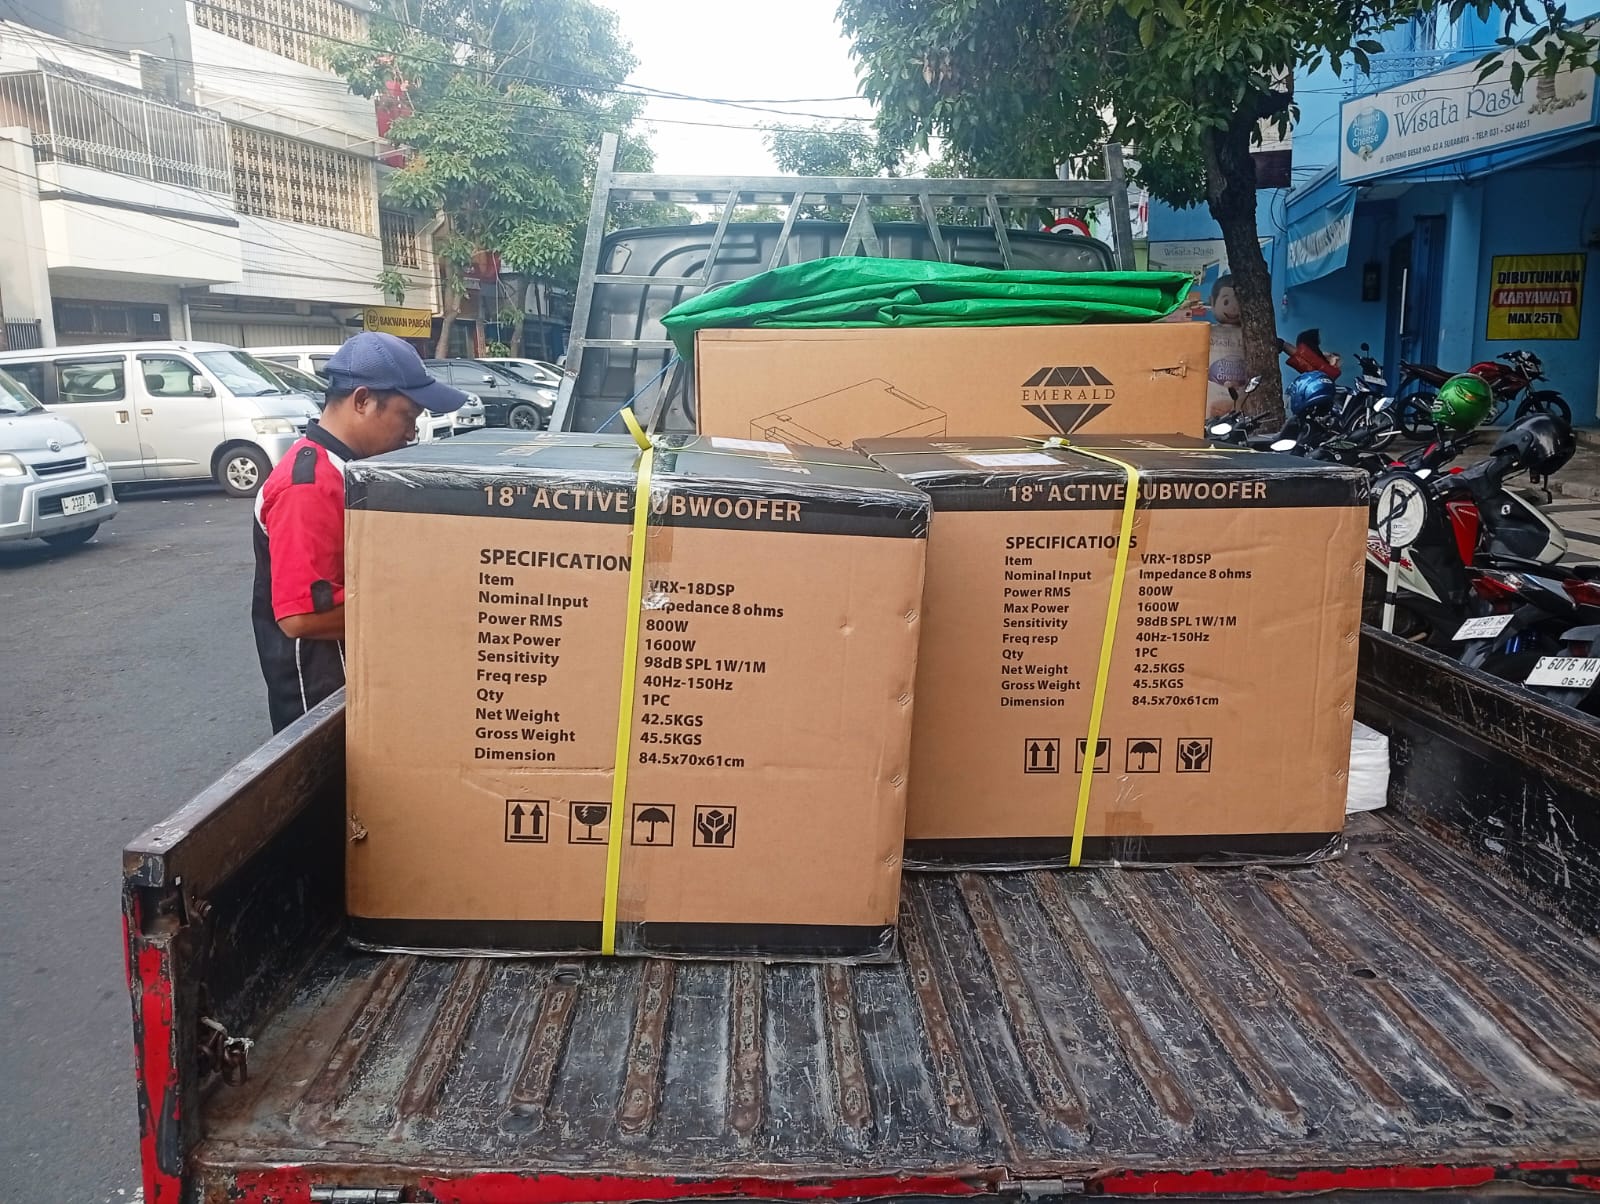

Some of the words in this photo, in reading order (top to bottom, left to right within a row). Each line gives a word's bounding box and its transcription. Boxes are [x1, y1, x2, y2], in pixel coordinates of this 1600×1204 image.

[1394, 88, 1427, 108] TOKO
[1394, 97, 1460, 137] Wisata
[1465, 87, 1526, 119] Rasa
[1354, 127, 1377, 138] Crispy
[1352, 134, 1379, 148] Cheese
[1443, 135, 1470, 148] SURABAYA
[1498, 290, 1572, 305] KARYAWATI
[380, 316, 407, 328] BAKWAN
[408, 318, 431, 329] PABEAN
[1507, 312, 1532, 325] MAX
[1022, 388, 1116, 401] EMERALD
[1008, 484, 1043, 502] 18"
[1048, 484, 1125, 502] ACTIVE
[484, 486, 527, 508] 18"
[534, 488, 628, 513] ACTIVE
[650, 495, 801, 522] UBWOOFER
[1006, 536, 1137, 549] SPECIFICATIOS
[1005, 556, 1032, 566] Item
[1141, 554, 1212, 564] VRX-18DSP
[1004, 570, 1056, 580] Nominal
[1059, 570, 1092, 582] Input
[1140, 569, 1206, 580] Impedance
[1209, 570, 1216, 579] 8
[1219, 570, 1252, 579] ohms
[479, 572, 514, 586] Item
[648, 580, 735, 596] VRX-18DSP
[1004, 588, 1042, 597] Power
[1044, 588, 1070, 596] RMS
[1139, 586, 1173, 596] 800W
[479, 591, 544, 606] Nominal
[547, 594, 589, 608] Input
[733, 604, 740, 615] 8
[744, 605, 784, 618] ohms
[1004, 604, 1028, 613] Max
[1032, 603, 1069, 613] Power
[1138, 602, 1180, 612] 1600W
[478, 612, 526, 626] Power
[530, 615, 562, 627] RMS
[646, 619, 688, 632] 800W
[1003, 618, 1068, 630] Sensitivity
[1137, 616, 1168, 626] 98dB
[1170, 616, 1192, 626] SPL
[1196, 616, 1237, 627] 1W/1M
[478, 632, 510, 645] Max
[513, 634, 561, 647] Power
[645, 639, 696, 652] 1600W
[1002, 634, 1030, 645] Freq
[1032, 635, 1058, 645] resp
[1136, 632, 1210, 642] 40Hz-150Hz
[478, 650, 559, 667] Sensitivity
[644, 657, 682, 670] 98dB
[686, 658, 712, 671] SPL
[716, 660, 766, 673] 1W/1M
[1002, 649, 1024, 661] Qty
[1135, 648, 1158, 658] 1PC
[1002, 665, 1024, 674] Net
[1026, 664, 1068, 676] Weight
[1134, 664, 1185, 673] 42.5KGS
[1535, 657, 1546, 670] S
[1547, 658, 1579, 671] 6076
[477, 669, 511, 684] Freq
[514, 673, 547, 686] resp
[643, 676, 733, 691] 40Hz-150Hz
[1002, 680, 1035, 690] Gross
[1038, 680, 1080, 691] Weight
[1133, 679, 1184, 688] 45.5KGS
[476, 689, 504, 703] Qty
[642, 695, 670, 706] 1PC
[1001, 697, 1065, 706] Dimension
[1132, 696, 1219, 706] 84.5x70x61cm
[475, 708, 502, 721] Net
[506, 709, 560, 724] Weight
[641, 714, 703, 727] 42.5KGS
[475, 727, 518, 740] Gross
[521, 729, 576, 743] Weight
[640, 733, 702, 746] 45.5KGS
[474, 748, 555, 762] Dimension
[639, 752, 745, 767] 84.5x70x61cm
